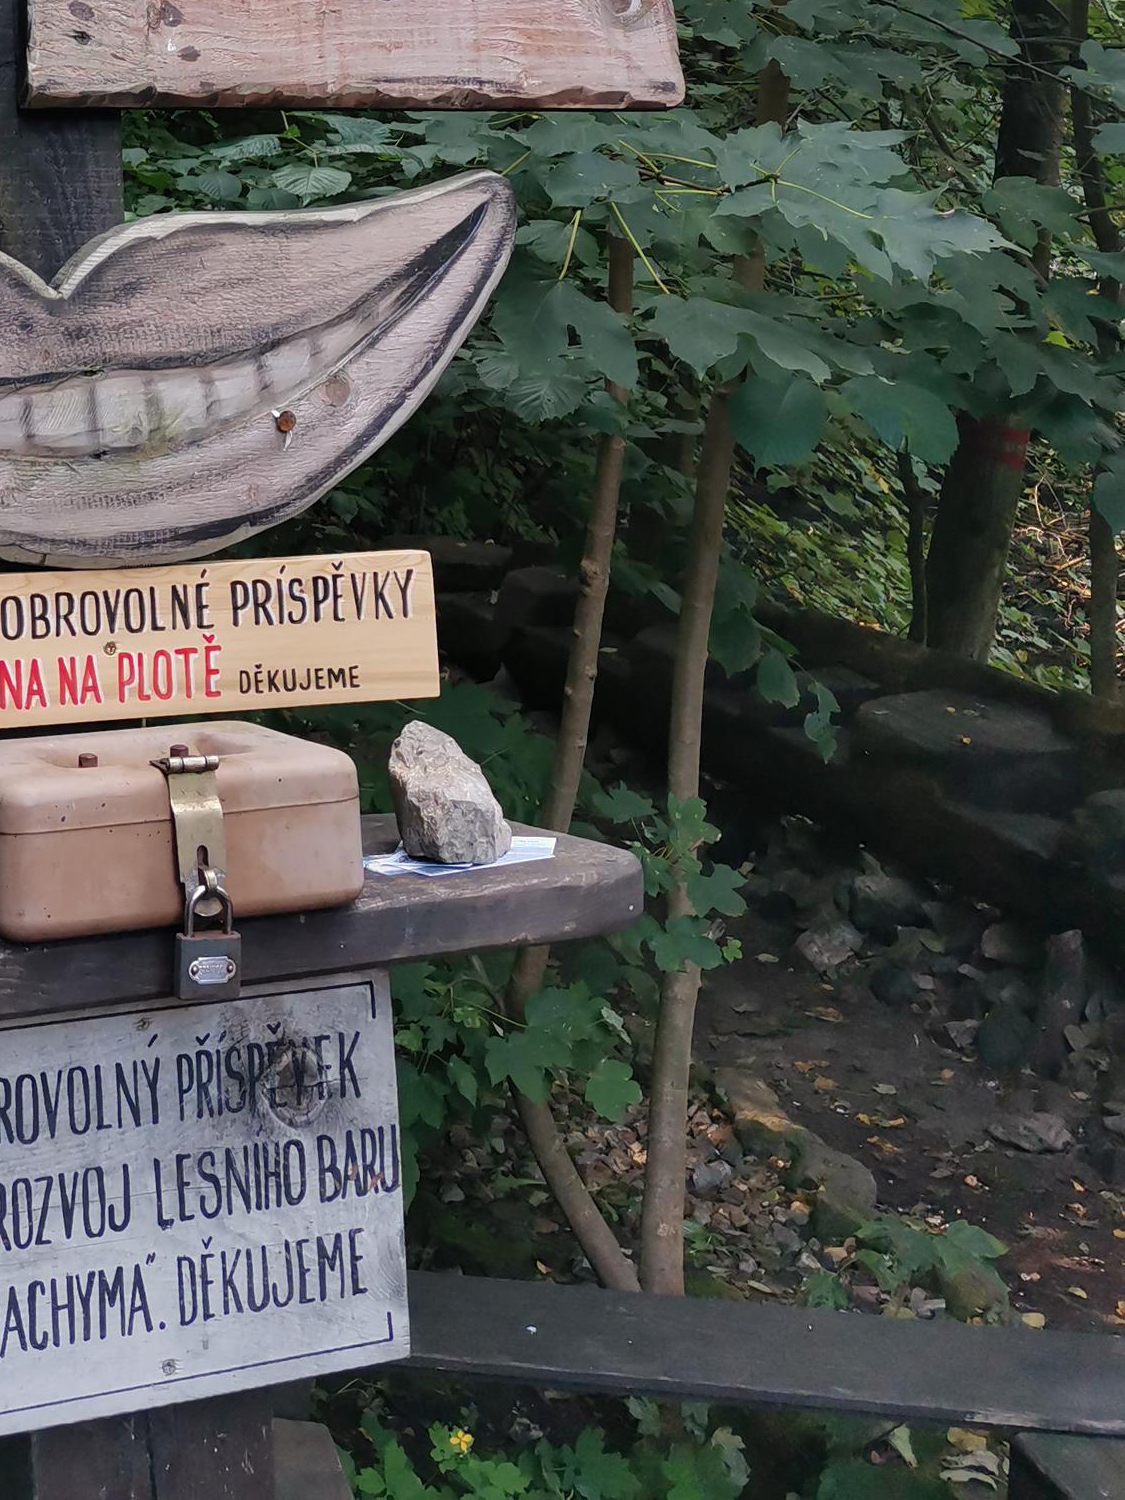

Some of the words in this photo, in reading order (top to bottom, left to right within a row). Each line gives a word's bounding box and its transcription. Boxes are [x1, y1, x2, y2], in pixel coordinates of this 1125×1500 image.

[57, 653, 102, 706] NA
[117, 633, 222, 703] PLOTĚ
[239, 663, 361, 695] DĚKUJEME
[176, 1021, 361, 1121] PŘÍSPĚVEK
[317, 1123, 400, 1204] BARU
[177, 1227, 368, 1328] DĚKUJEME
